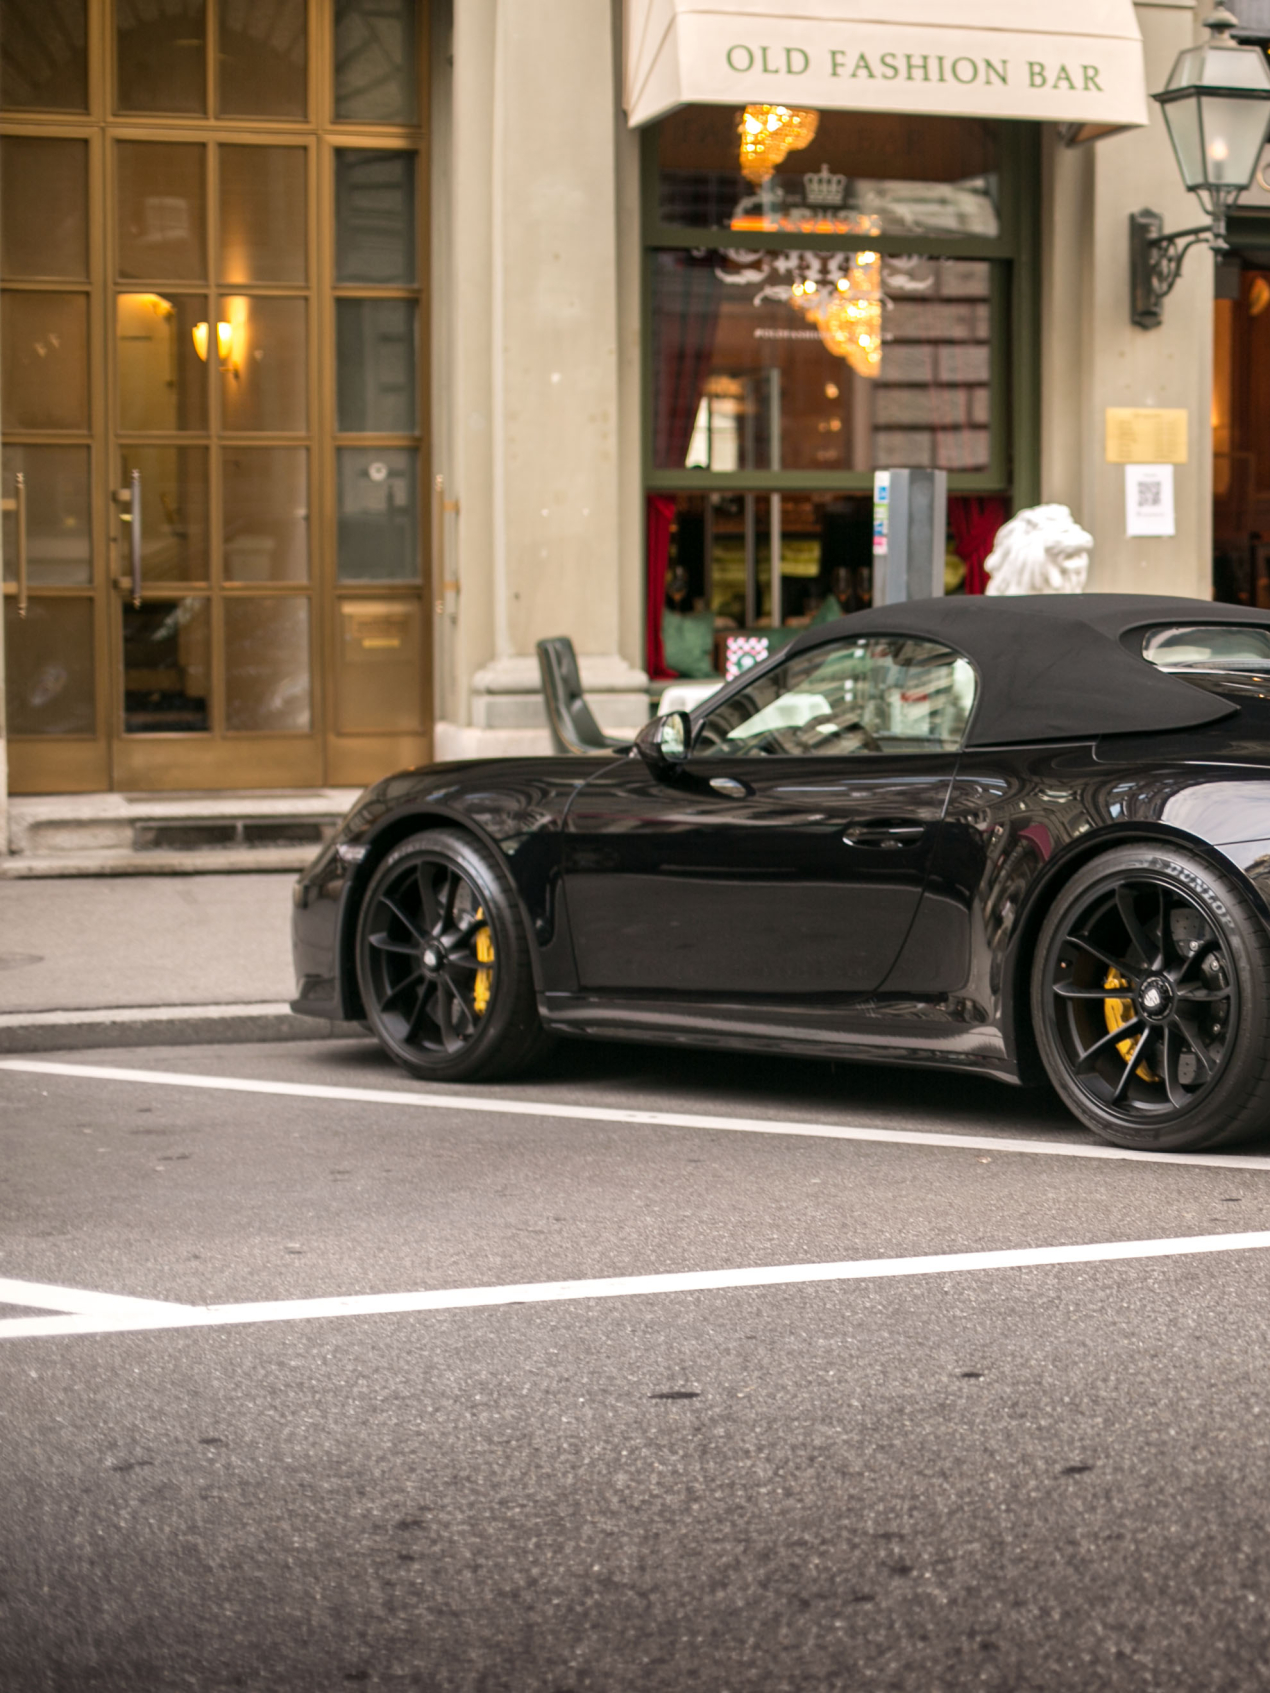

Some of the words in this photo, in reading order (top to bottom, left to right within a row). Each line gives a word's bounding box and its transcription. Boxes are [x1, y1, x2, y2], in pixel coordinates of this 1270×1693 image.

[726, 44, 810, 76] OLD
[828, 49, 1010, 86] FASHION
[1026, 60, 1104, 92] BAR
[1165, 862, 1235, 928] DUNLOP
